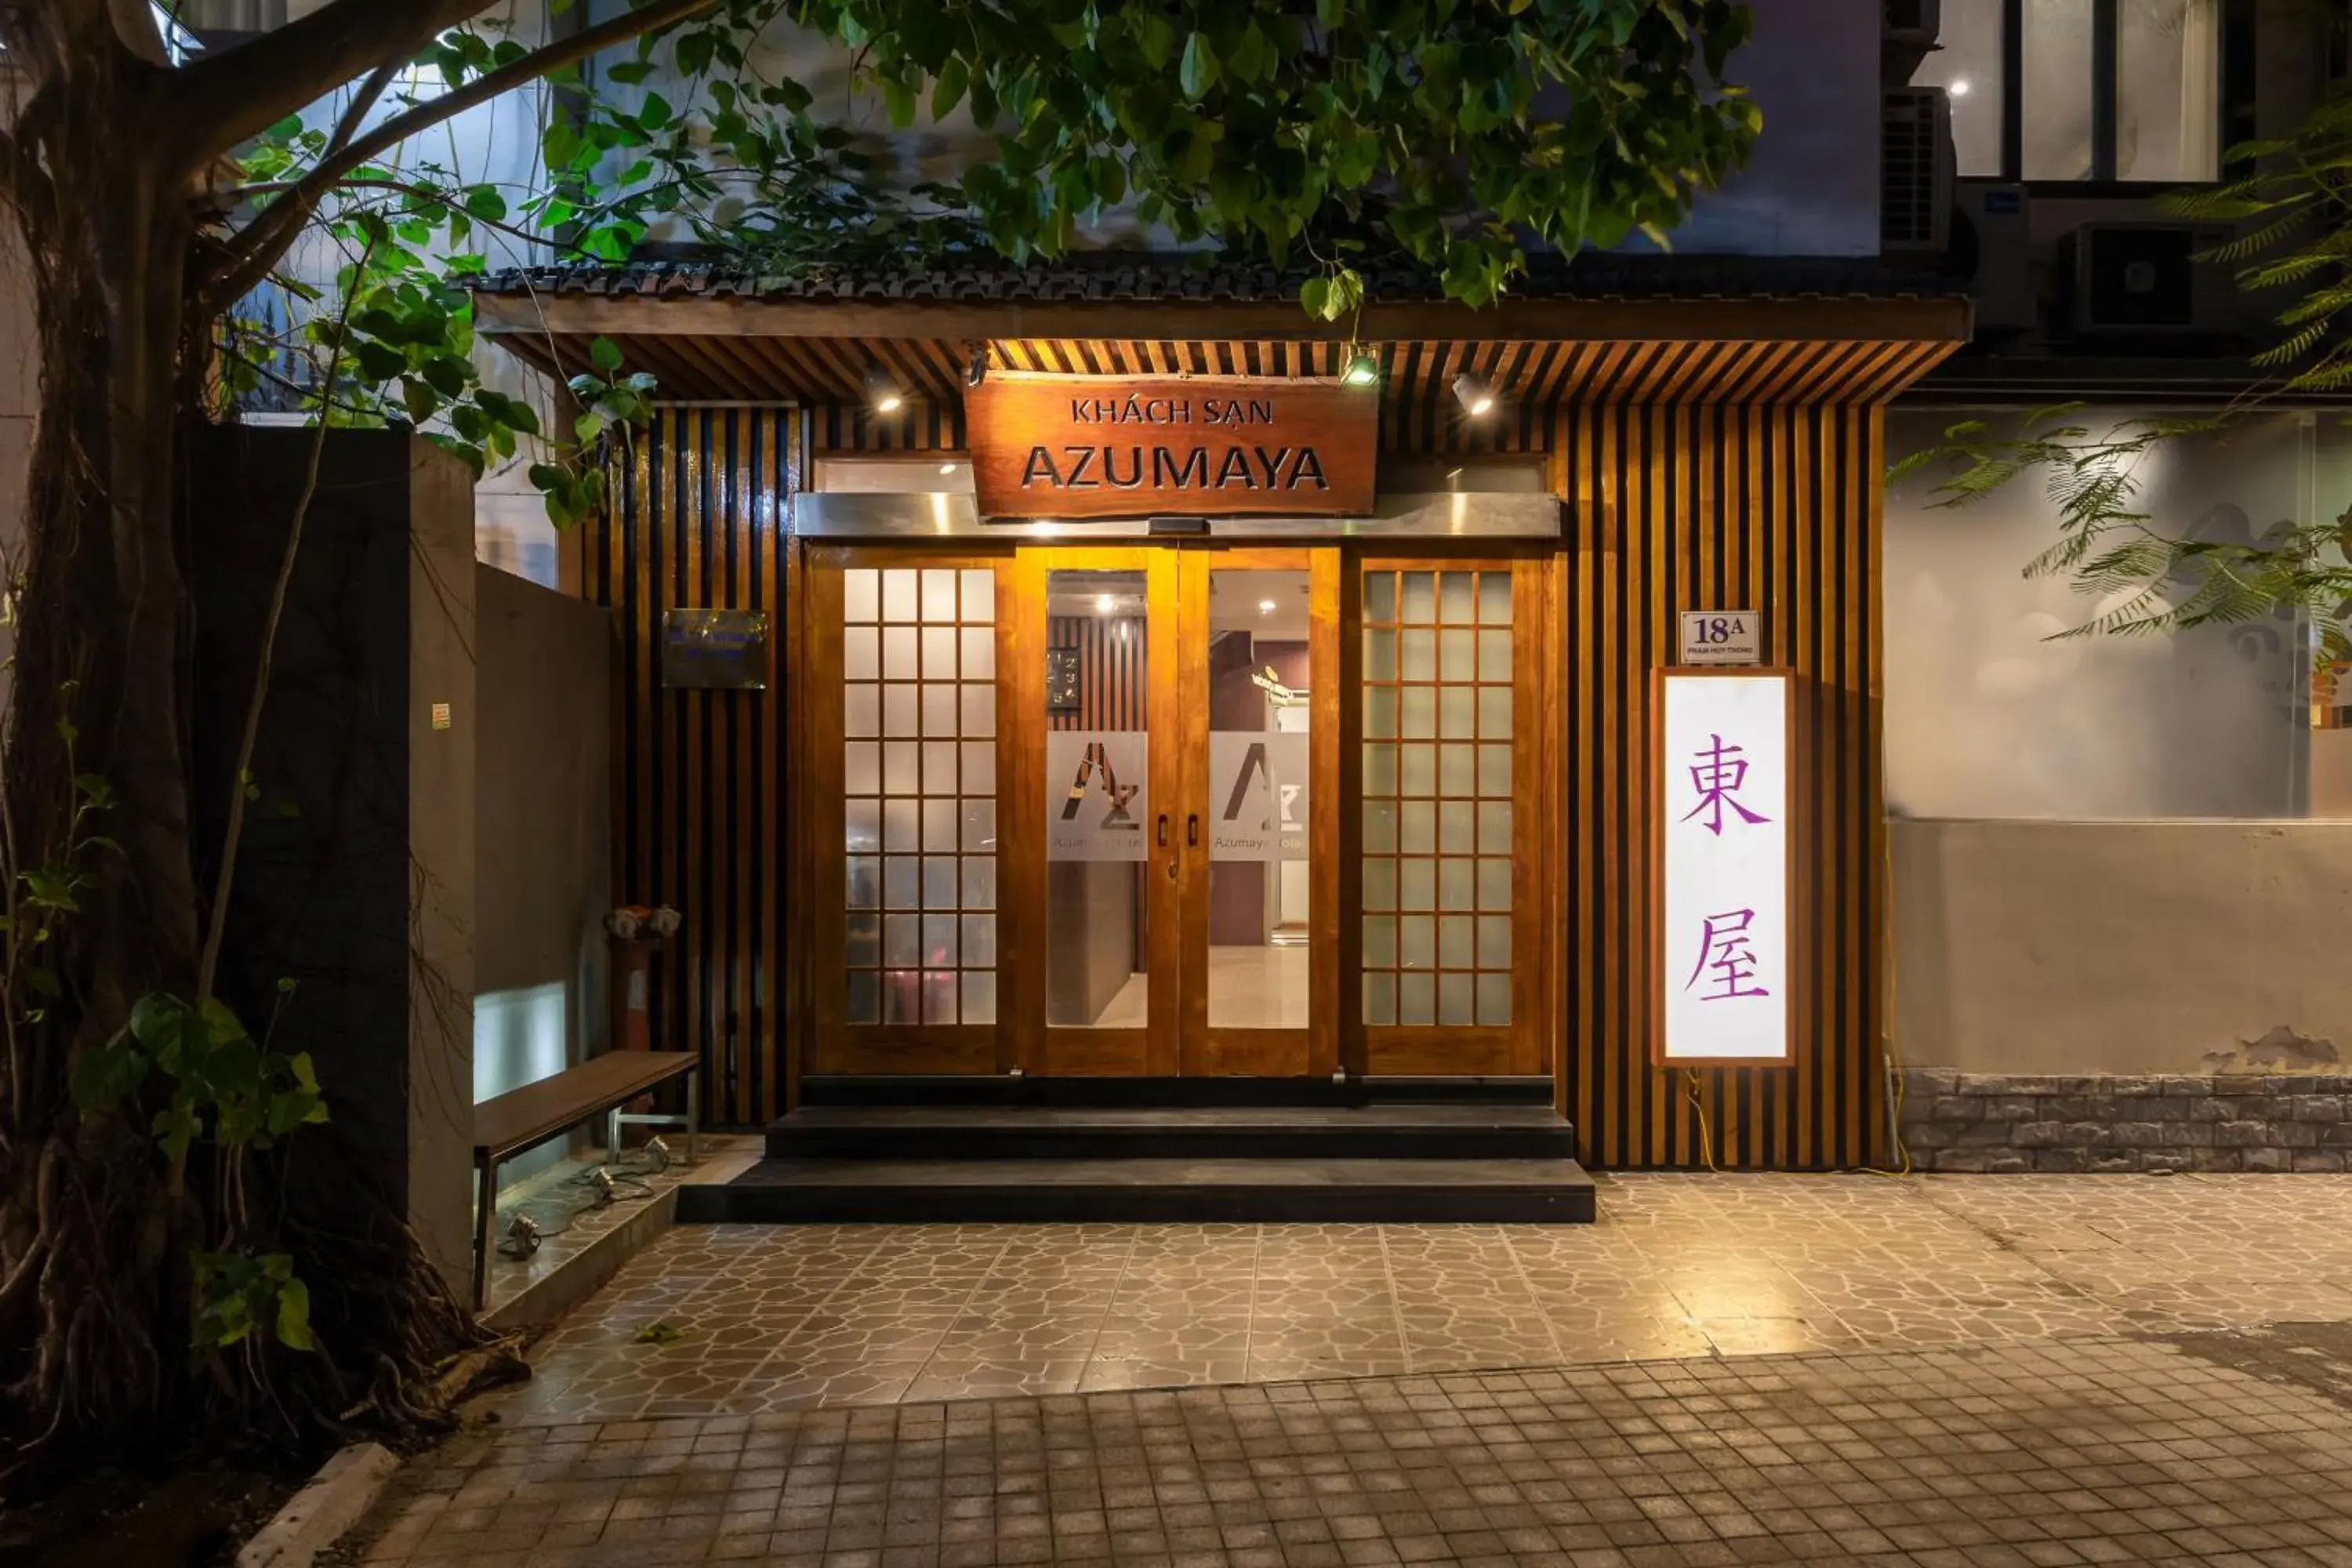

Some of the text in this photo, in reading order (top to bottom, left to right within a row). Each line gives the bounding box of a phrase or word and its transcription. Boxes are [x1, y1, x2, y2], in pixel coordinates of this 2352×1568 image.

[1071, 392, 1273, 430] KHÁCH SẠN
[1022, 445, 1330, 490] AZUMAYA
[1679, 733, 1773, 1000] 東屋
